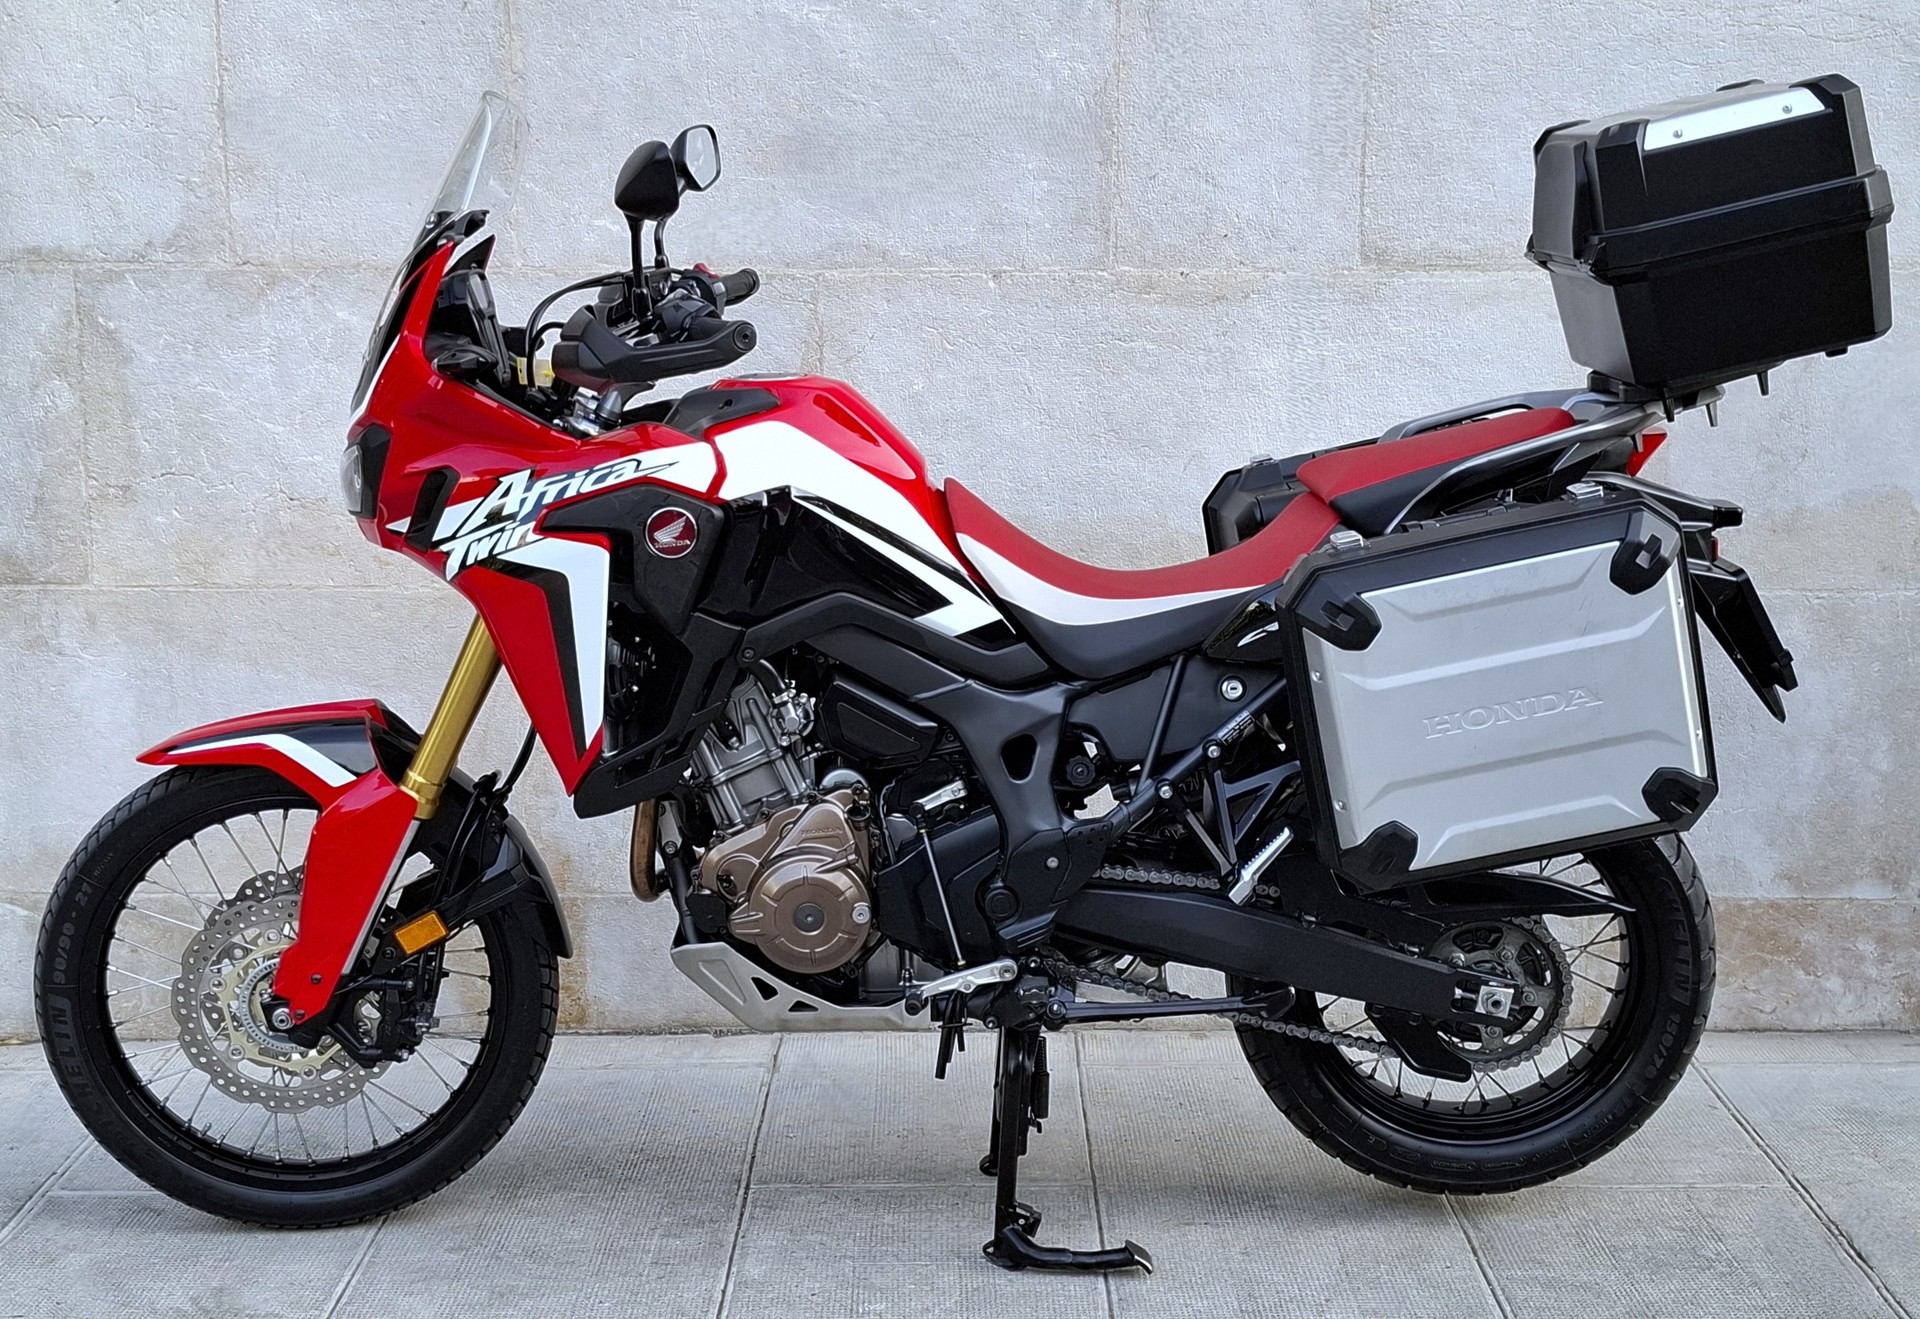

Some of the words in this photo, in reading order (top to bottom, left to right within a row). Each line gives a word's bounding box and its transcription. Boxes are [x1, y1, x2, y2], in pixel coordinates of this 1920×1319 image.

[456, 459, 679, 537] Africa
[439, 520, 544, 581] Twin
[654, 540, 692, 549] HONDA
[1423, 686, 1604, 740] HONDA
[801, 827, 843, 837] HONDA
[52, 920, 76, 985] 90/90
[74, 881, 94, 908] 21
